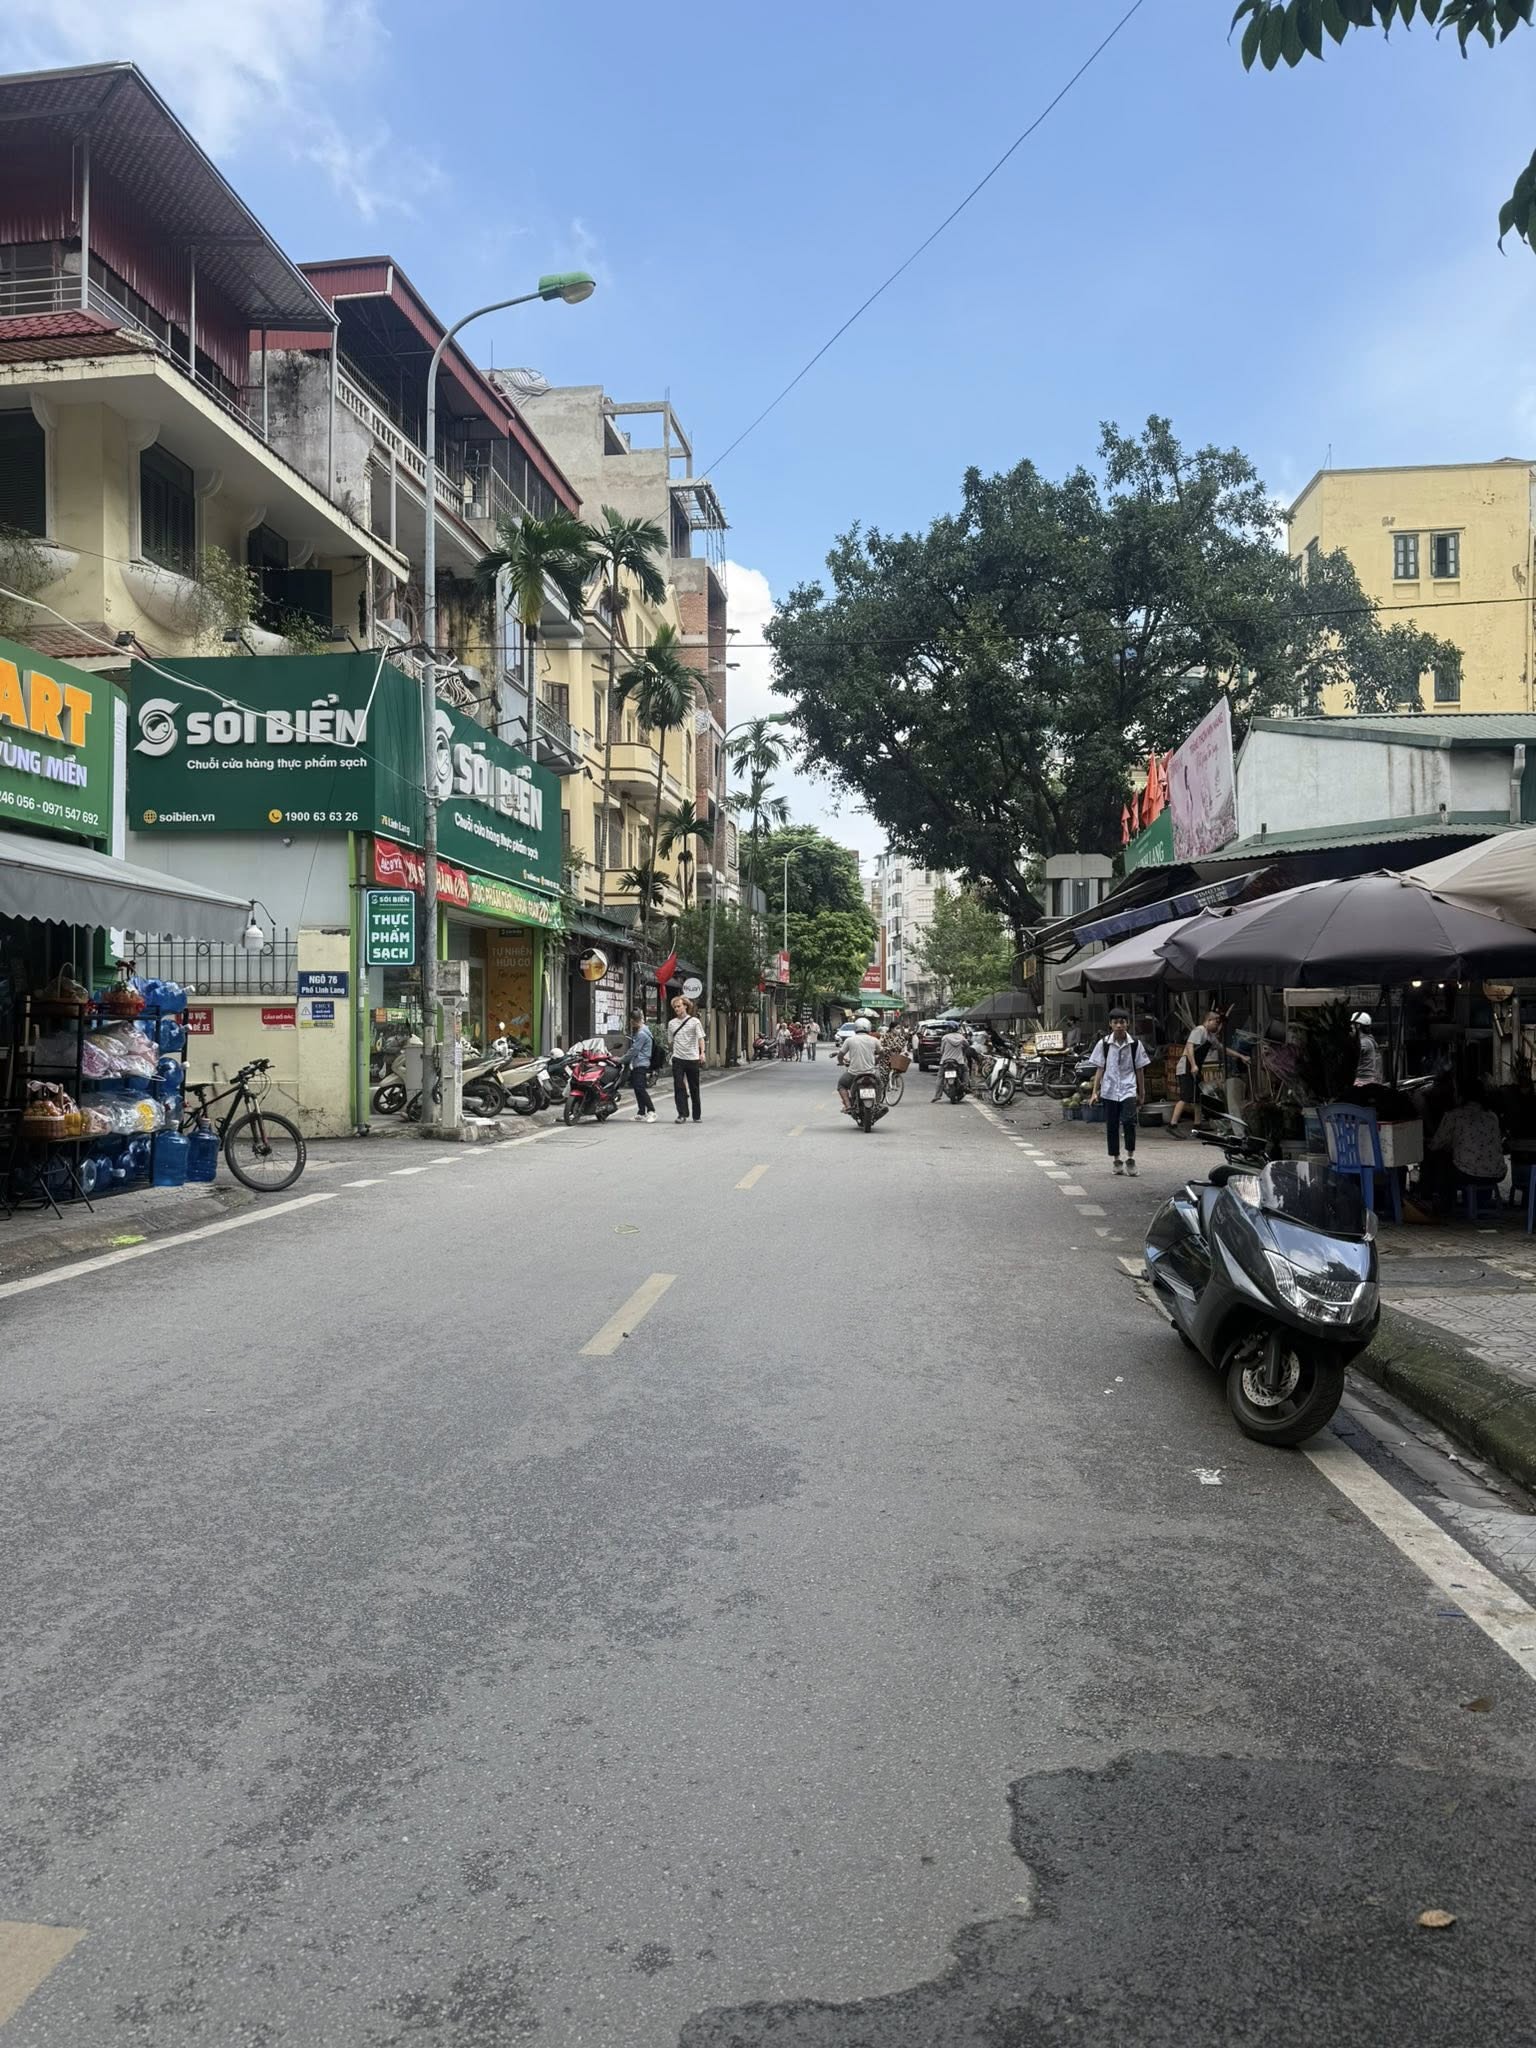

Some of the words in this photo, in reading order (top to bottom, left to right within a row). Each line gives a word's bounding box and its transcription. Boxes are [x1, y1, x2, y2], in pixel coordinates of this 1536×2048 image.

[265, 693, 367, 745] BIỂN
[187, 758, 219, 770] Chuỗi
[222, 758, 243, 769] cửa
[246, 758, 274, 771] hàng
[277, 758, 301, 771] thực
[304, 754, 337, 771] phẩm
[340, 757, 368, 770] sạch
[16, 794, 36, 811] 056
[42, 801, 64, 818] 0971
[65, 806, 82, 822] 547
[82, 811, 99, 827] 692
[159, 812, 216, 822] soibien.vn
[285, 811, 311, 822] 1900
[313, 811, 327, 822] 63
[329, 811, 342, 822] 63
[345, 811, 359, 822] 26
[455, 811, 473, 833] Chuỗi
[372, 913, 409, 928] THỰC
[371, 927, 410, 943] PHẨM
[373, 947, 408, 960] SẠCH
[308, 973, 326, 985] NGÕ
[301, 985, 314, 994] Phố
[315, 986, 329, 994] Linh
[331, 986, 345, 996] Lang
